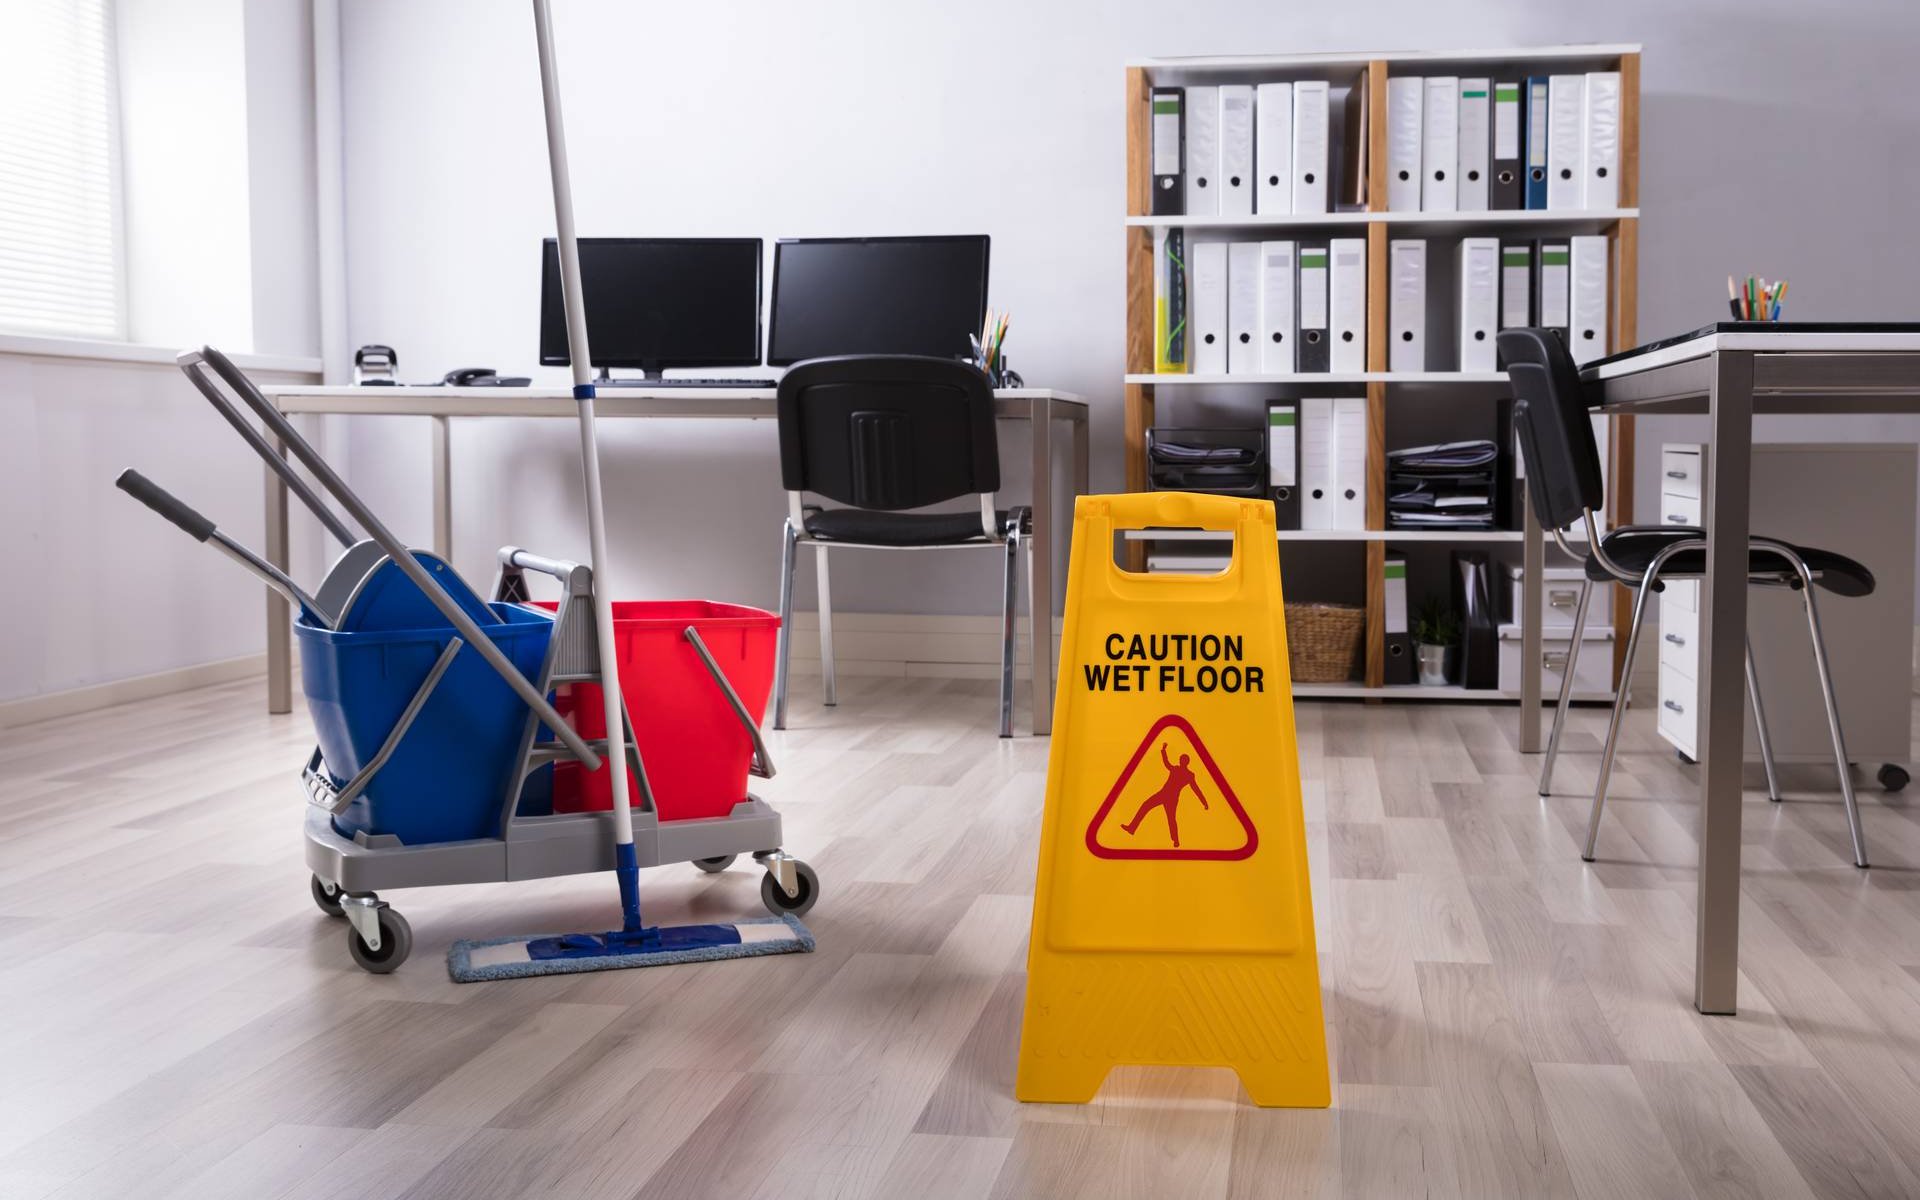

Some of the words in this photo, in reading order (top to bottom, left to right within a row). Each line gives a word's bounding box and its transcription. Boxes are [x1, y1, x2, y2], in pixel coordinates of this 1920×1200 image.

[1105, 633, 1243, 661] CAUTION
[1084, 665, 1151, 692] WET
[1159, 665, 1265, 693] FLOOR
